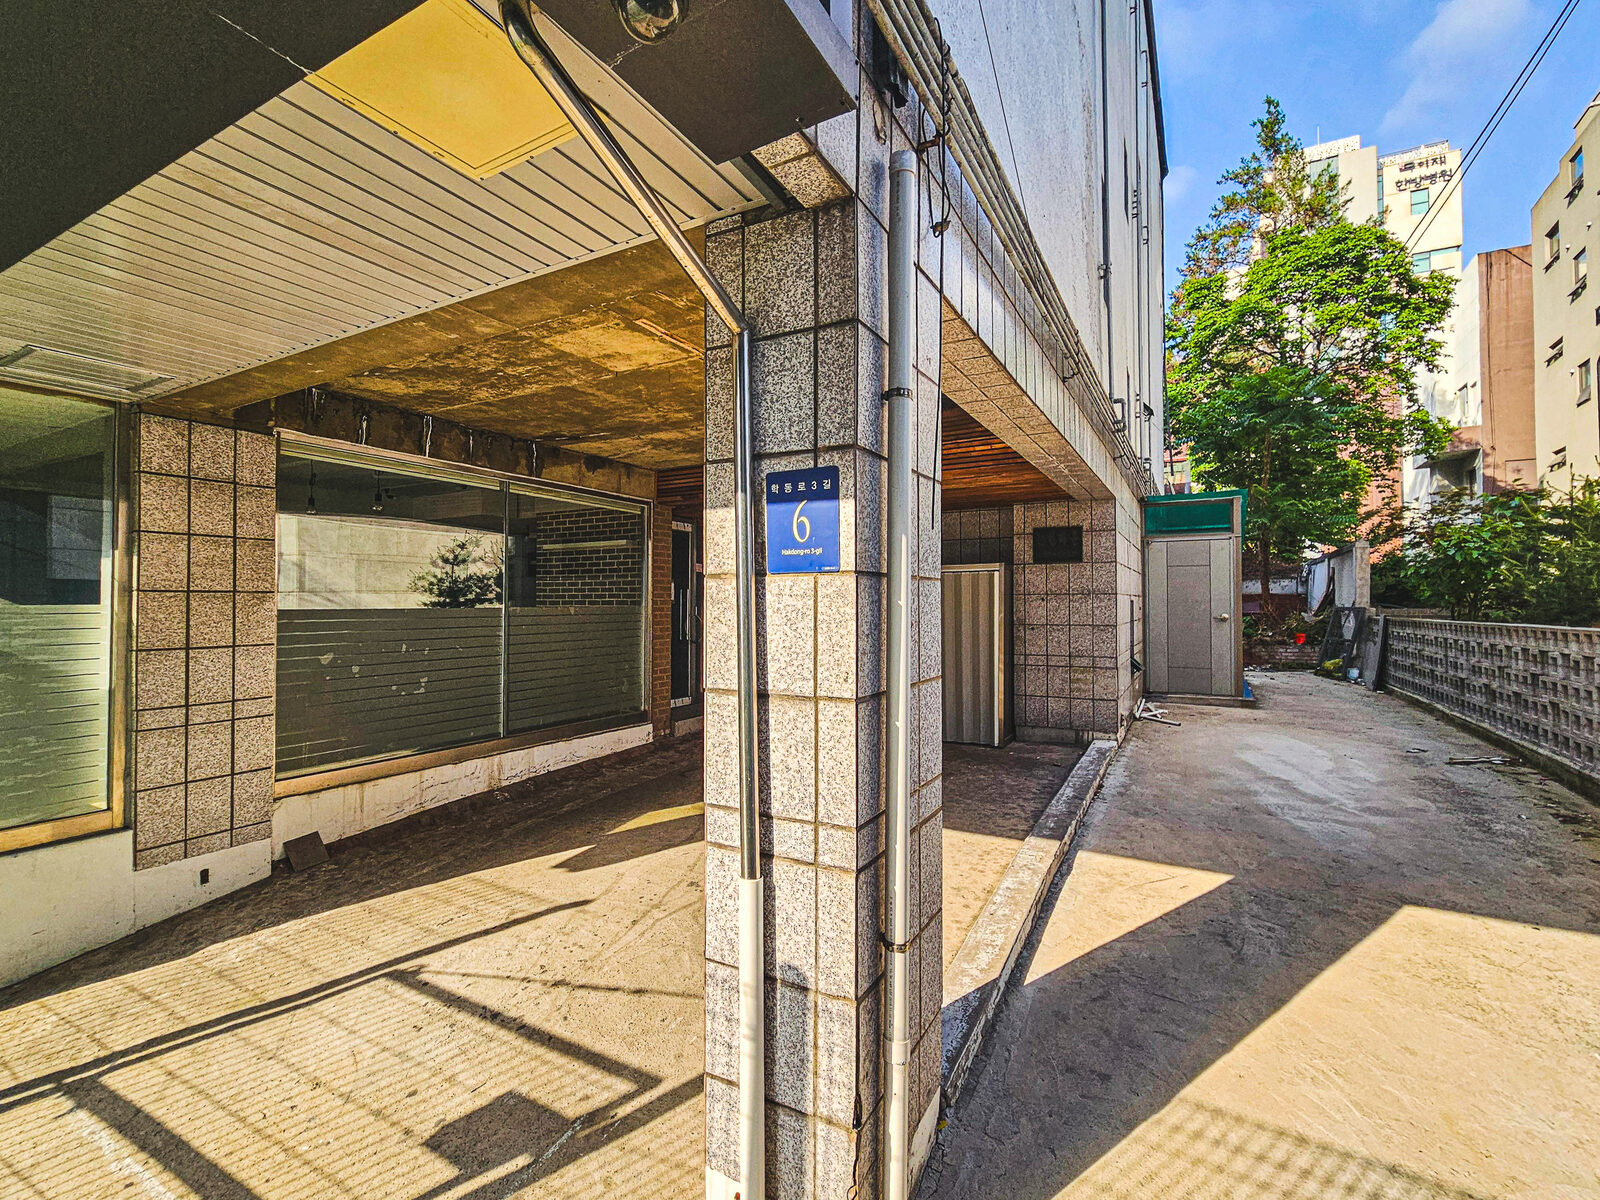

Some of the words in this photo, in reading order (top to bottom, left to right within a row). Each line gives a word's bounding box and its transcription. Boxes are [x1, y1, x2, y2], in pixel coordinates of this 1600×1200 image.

[1395, 168, 1452, 192] 한방병원
[792, 500, 811, 543] 6
[781, 548, 811, 556] Hakdong-ro
